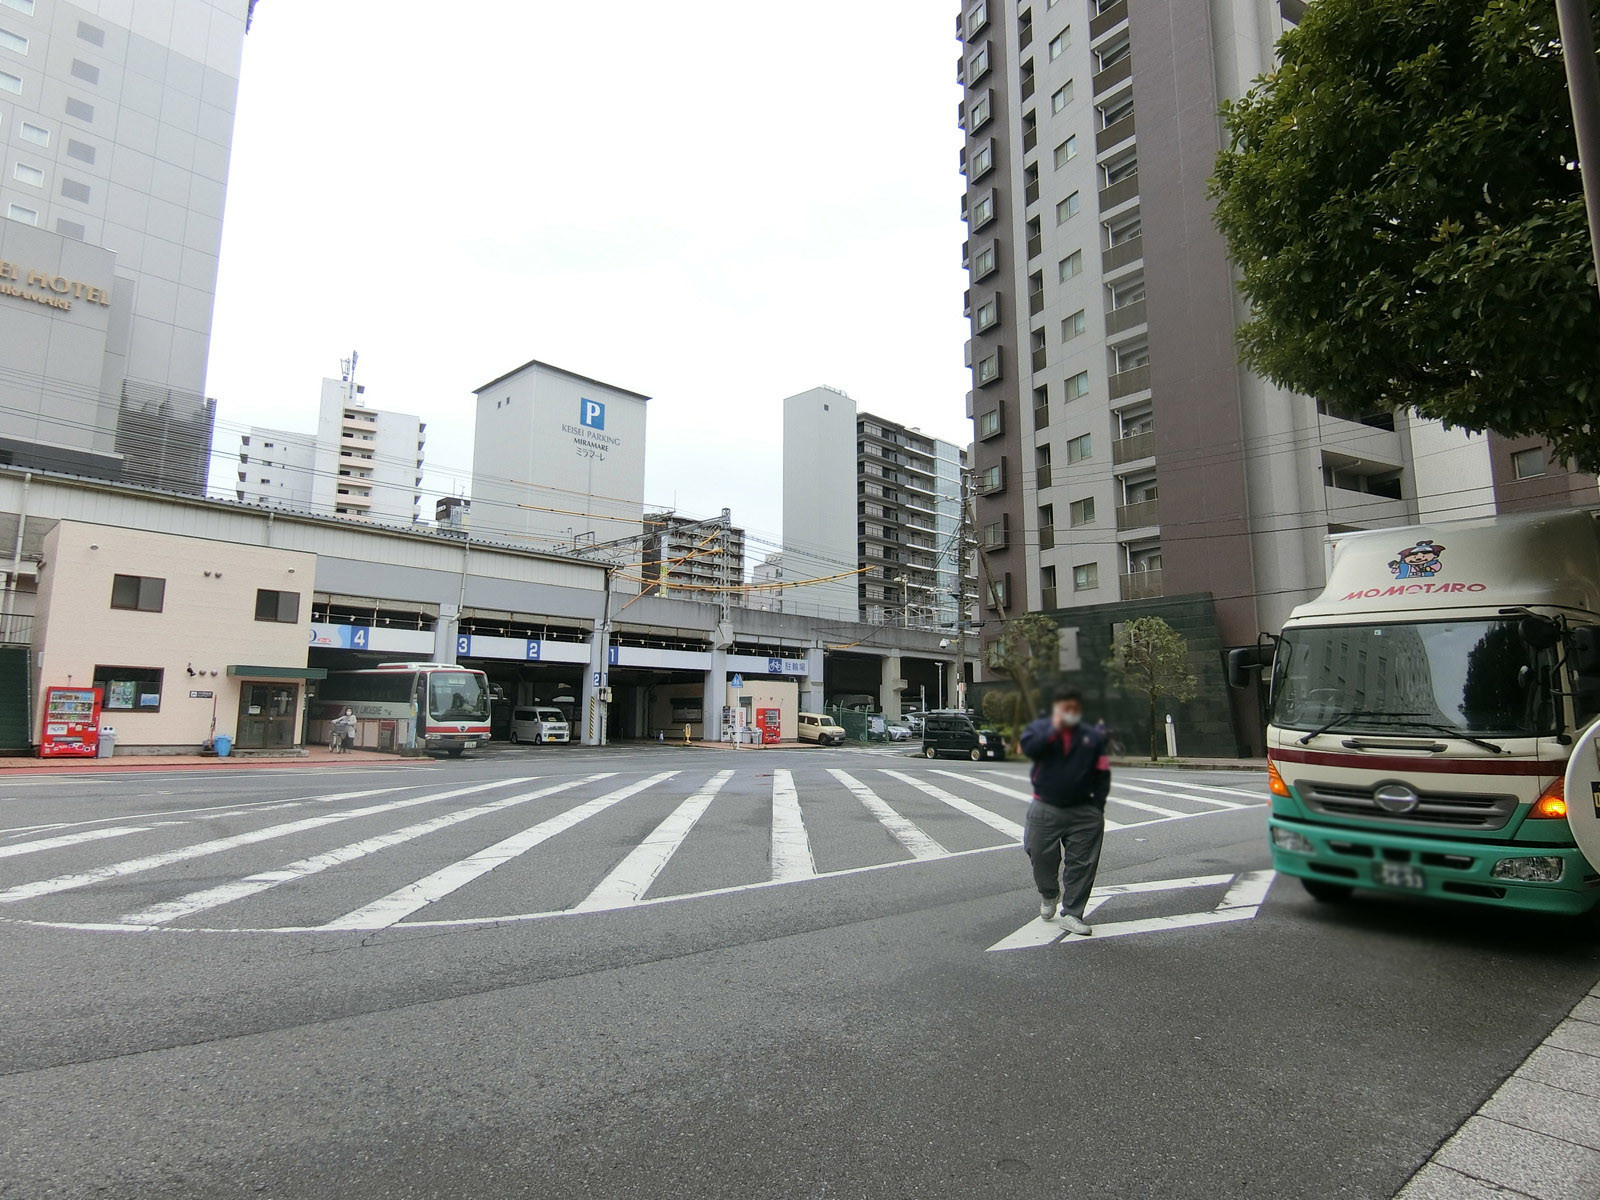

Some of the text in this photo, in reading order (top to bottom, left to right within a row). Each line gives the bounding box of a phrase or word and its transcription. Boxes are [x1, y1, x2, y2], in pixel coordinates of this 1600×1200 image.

[28, 269, 111, 307] HOTEL
[0, 284, 72, 311] IRAMARE
[586, 402, 601, 425] P
[561, 423, 621, 446] KEISEI PARKING
[573, 437, 609, 452] MIRAMARE
[575, 446, 606, 462] ミラマーレ
[1339, 583, 1487, 602] MOMOTARO
[354, 629, 365, 647] 4
[458, 637, 468, 654] 3
[529, 642, 538, 658] 2
[610, 648, 615, 662] 1
[785, 662, 806, 672] 駐輪場
[594, 674, 600, 686] 2
